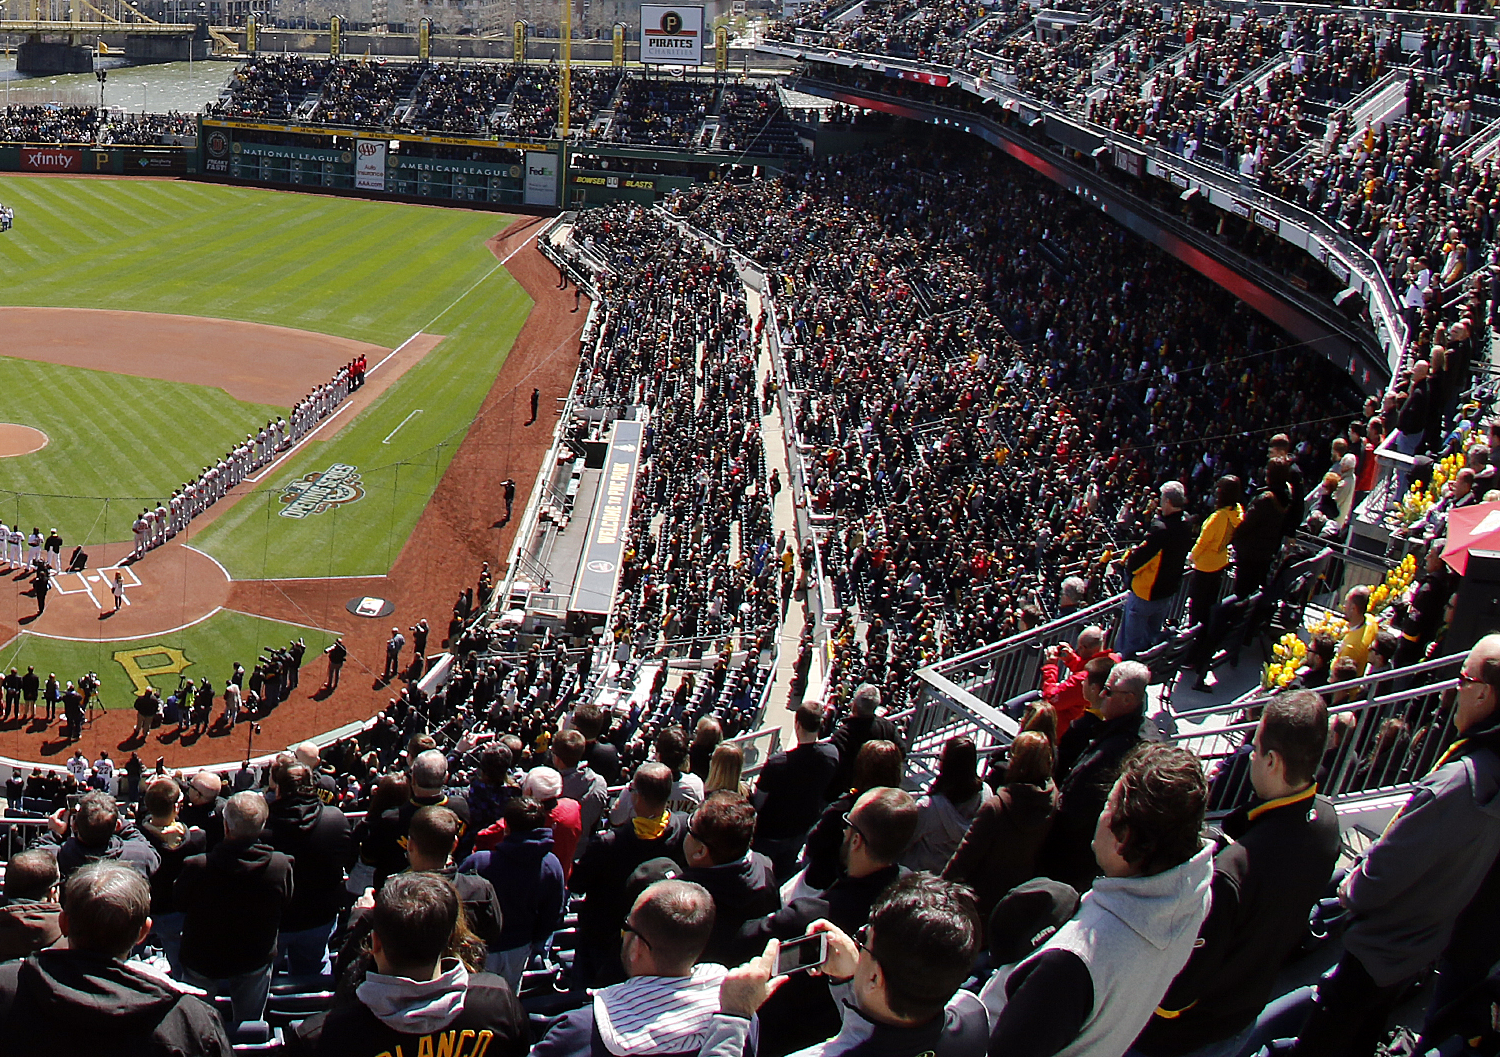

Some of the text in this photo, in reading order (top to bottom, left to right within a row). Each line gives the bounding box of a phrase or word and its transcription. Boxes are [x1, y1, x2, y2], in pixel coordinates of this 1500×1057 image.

[649, 38, 693, 48] PIRATES
[243, 148, 339, 163] NATIONAL LEAGUE
[359, 144, 376, 154] AAA
[28, 152, 73, 168] xfinity
[401, 162, 508, 177] AMERICAN LEAGUE
[529, 166, 553, 176] FedEx
[357, 180, 382, 188] AAA.com
[576, 176, 606, 185] BOWSER
[625, 180, 653, 188] BLASTS
[611, 462, 630, 481] PARK
[281, 464, 356, 518] OPENING SERIES
[607, 480, 627, 497] PNC
[597, 505, 622, 544] WELCOME
[111, 643, 197, 697] P
[375, 1029, 494, 1057] ANCO
